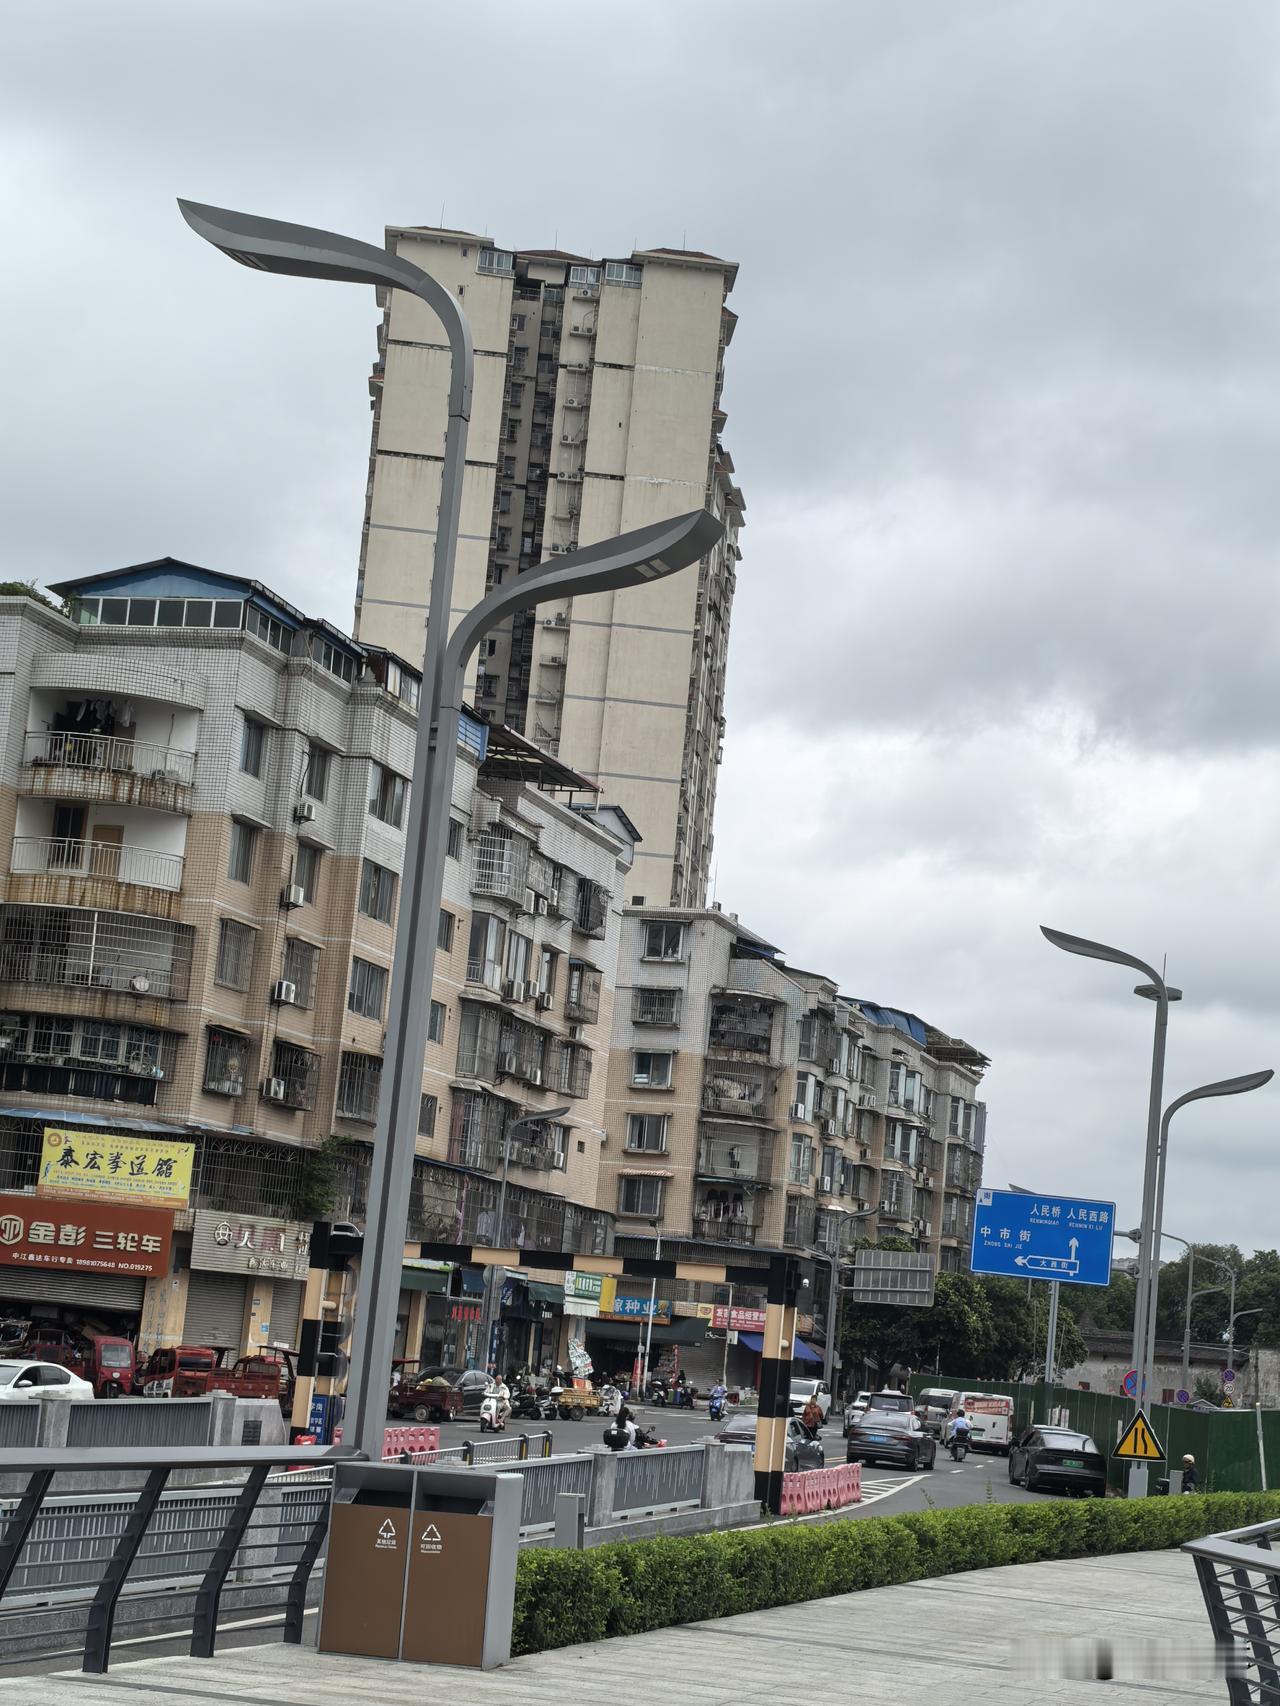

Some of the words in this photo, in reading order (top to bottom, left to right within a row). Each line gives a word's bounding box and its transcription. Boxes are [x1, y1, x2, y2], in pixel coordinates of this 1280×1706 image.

[1030, 1204, 1061, 1218] 人民桥
[1067, 1207, 1109, 1223] 人民西路
[28, 1221, 87, 1246] 金彭
[93, 1231, 162, 1252] 三轮车
[980, 1226, 1032, 1243] 中市街
